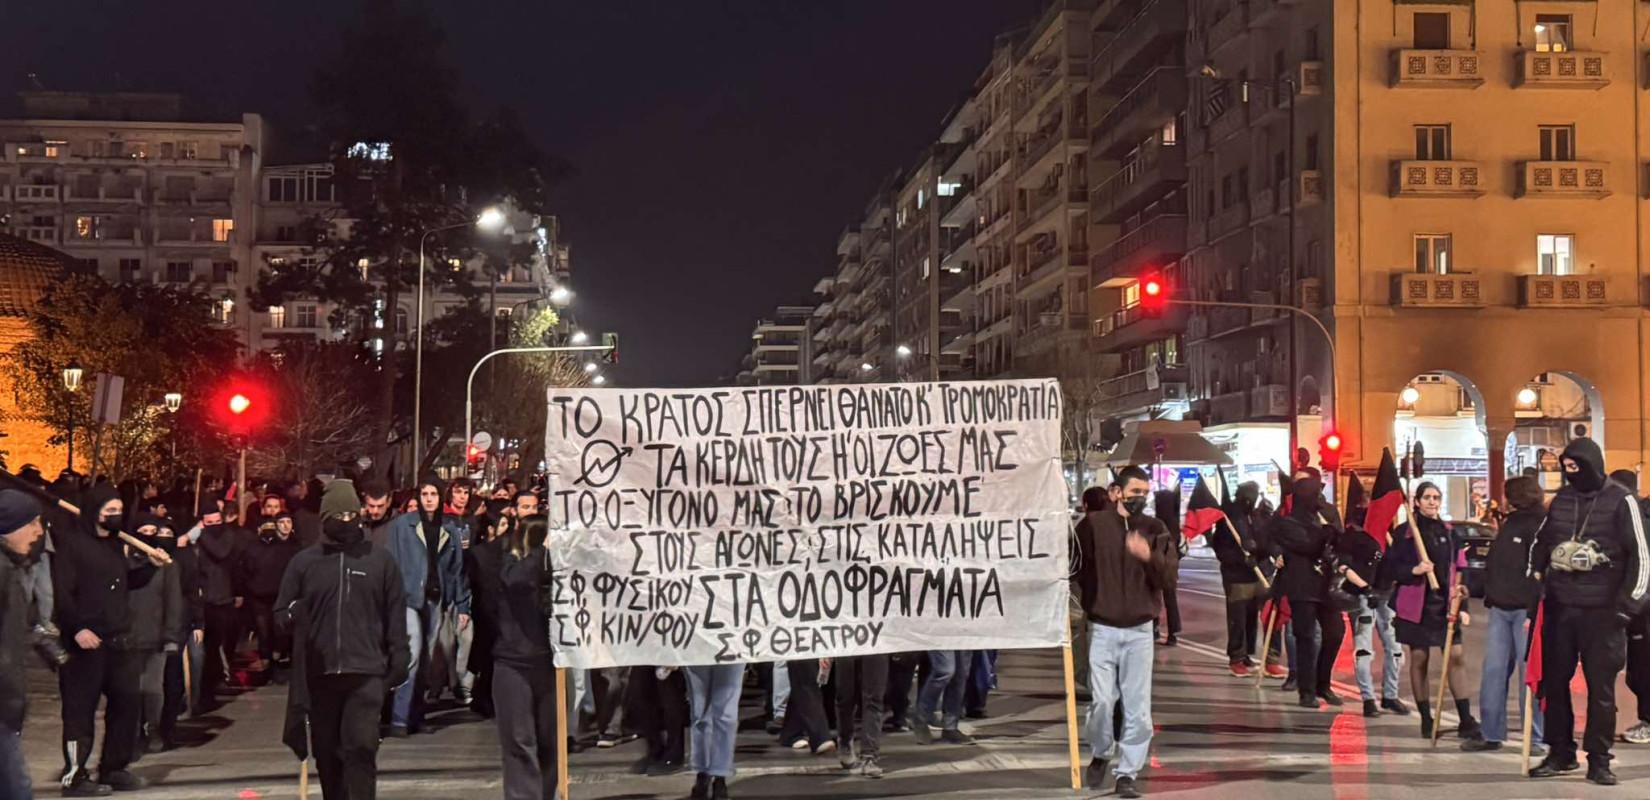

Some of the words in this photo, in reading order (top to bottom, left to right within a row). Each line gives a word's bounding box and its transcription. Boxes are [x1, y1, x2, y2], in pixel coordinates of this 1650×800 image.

[552, 396, 603, 439] ΤΟ
[619, 391, 732, 444] ΚΡΑΤΟΣ
[742, 387, 835, 435] ΣΠΕΡΝΕΙ
[838, 386, 913, 428] ΘΑΝΑΤΟ
[938, 382, 1059, 424] ΤΡΟΜΟΚΡΑΤΙΑ
[644, 443, 688, 488] ΤΑ
[696, 438, 767, 488] ΚΕΡΔΗ
[765, 434, 829, 481] ΤΟΥΣ
[957, 426, 1020, 475] ΜΑΣ
[554, 489, 598, 530] ΤΟ
[604, 488, 719, 531] ΟΞΥΓΟΝΟ
[788, 486, 822, 525] ΤΟ
[629, 530, 701, 577] ΣΤΟΥΣ
[877, 518, 1050, 560] ΚΑΤΑΛΗΨΕΙΣ
[592, 571, 694, 612] ΦΥΣΙΚΟΥ
[699, 572, 769, 629] ΣΤΑ
[777, 562, 1004, 622] ΟΔΟΦΡΑΓΜΑΤΑ
[770, 621, 883, 655] ΘΕΑΤΡΟΥ
